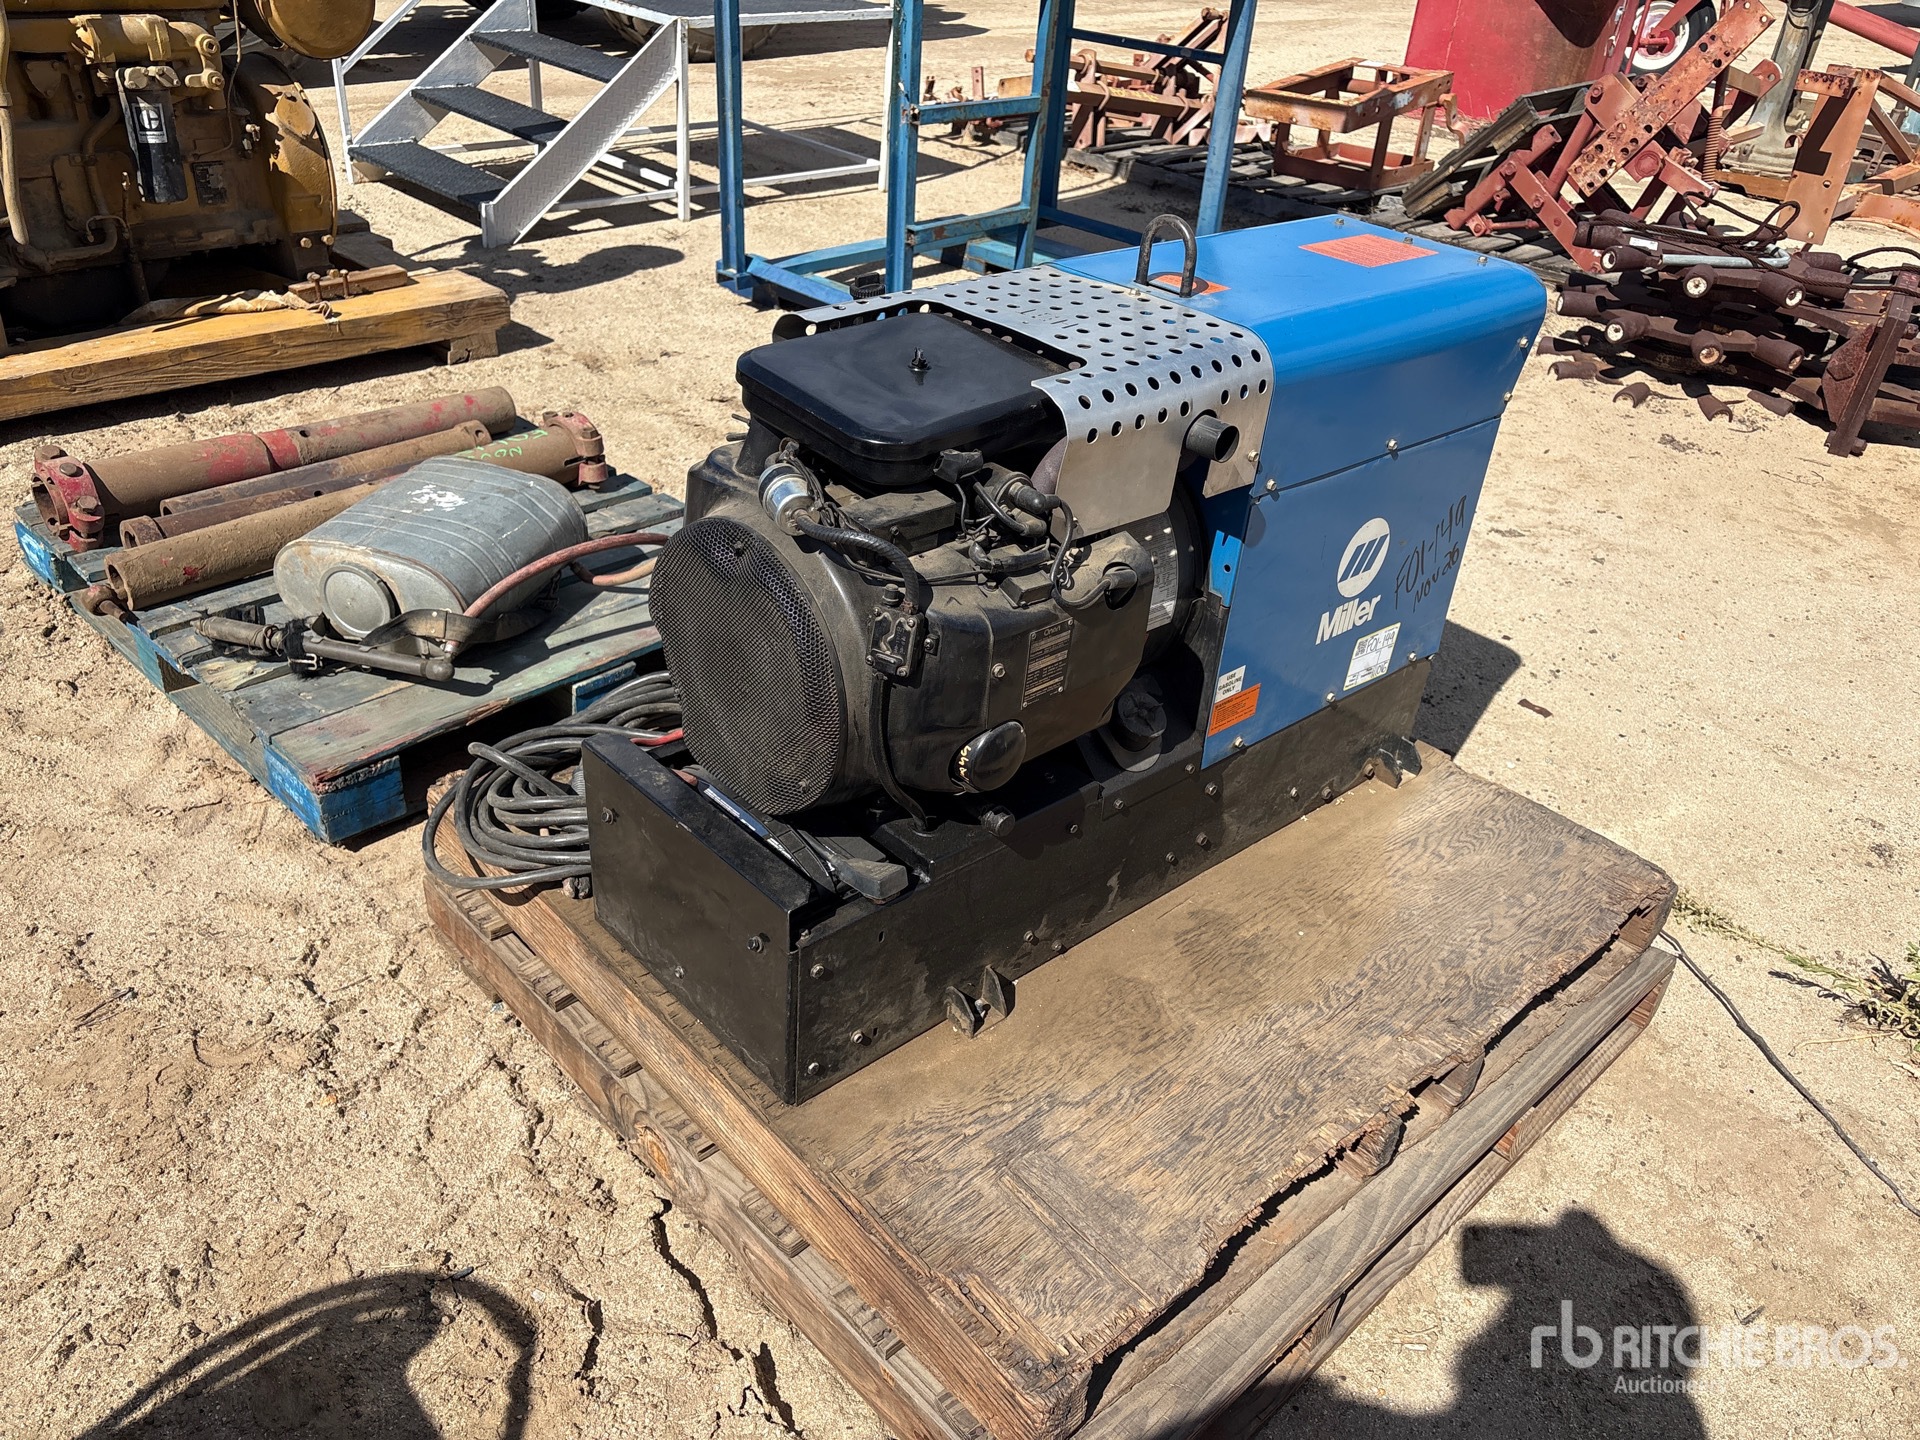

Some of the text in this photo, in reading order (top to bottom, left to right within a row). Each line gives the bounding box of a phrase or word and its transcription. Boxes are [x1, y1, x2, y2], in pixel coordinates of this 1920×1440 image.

[1315, 595, 1382, 645] Miller
[1218, 675, 1242, 691] GASOLINE
[1226, 672, 1237, 681] USE
[1222, 685, 1236, 695] ONLY
